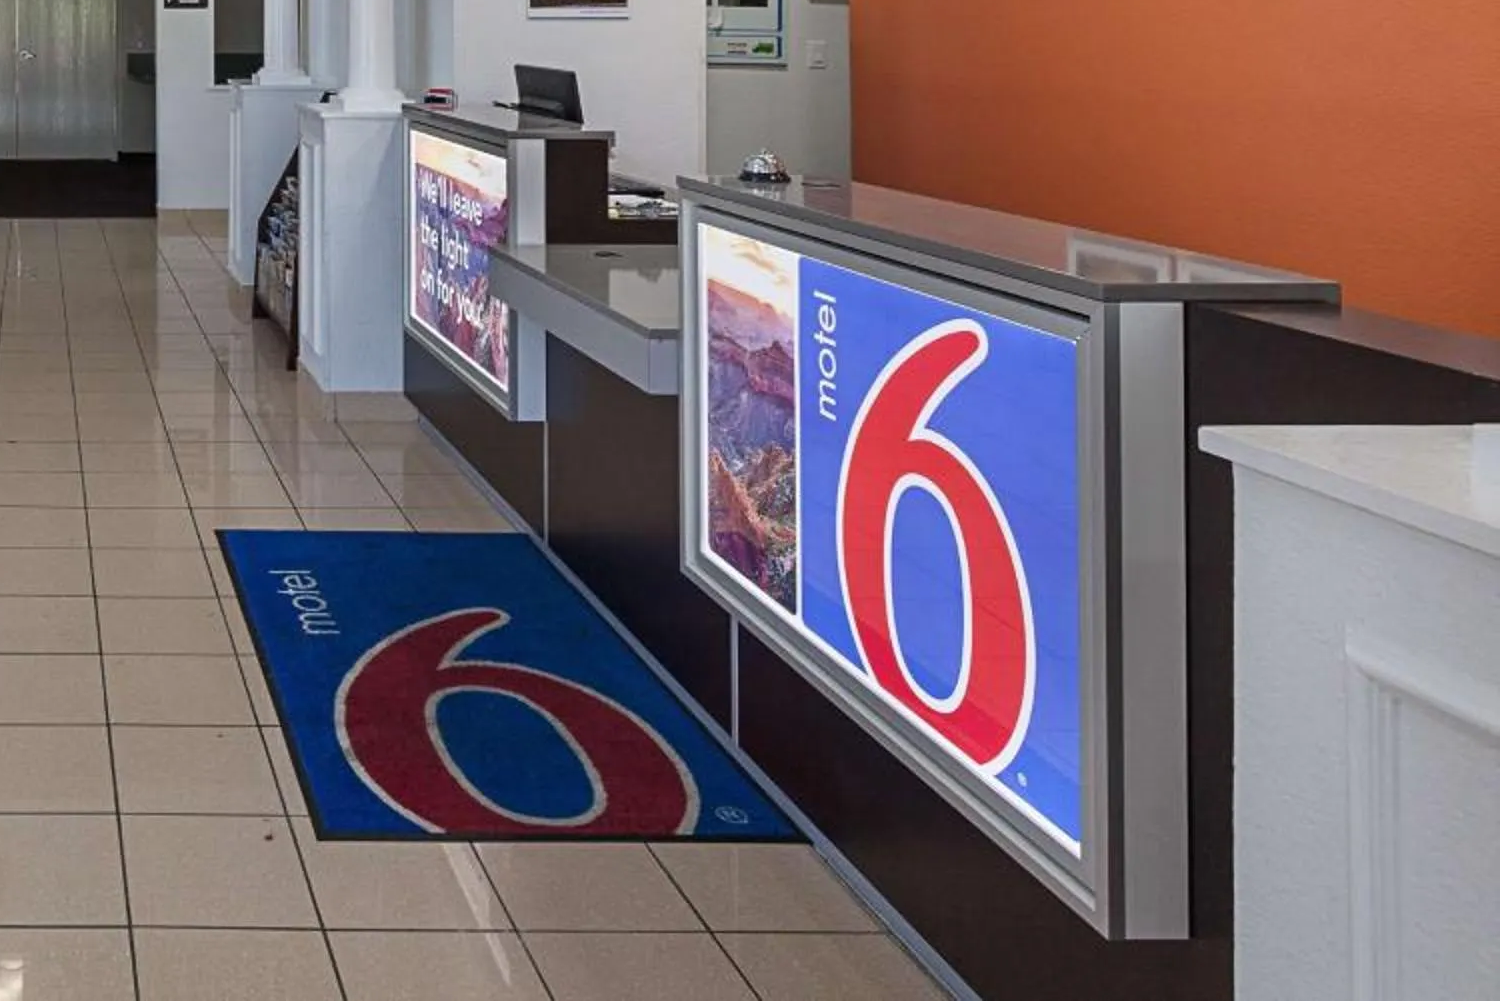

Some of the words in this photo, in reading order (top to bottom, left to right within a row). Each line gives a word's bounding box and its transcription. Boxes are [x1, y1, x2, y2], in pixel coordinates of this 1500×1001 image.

[419, 168, 447, 208] We'll
[449, 179, 484, 226] leave
[420, 213, 439, 249] the
[441, 222, 469, 270] light
[420, 267, 435, 296] on
[437, 268, 455, 307] for
[812, 288, 838, 422] motel
[837, 318, 1036, 777] 6
[268, 570, 341, 635] motel
[334, 607, 699, 836] 6
